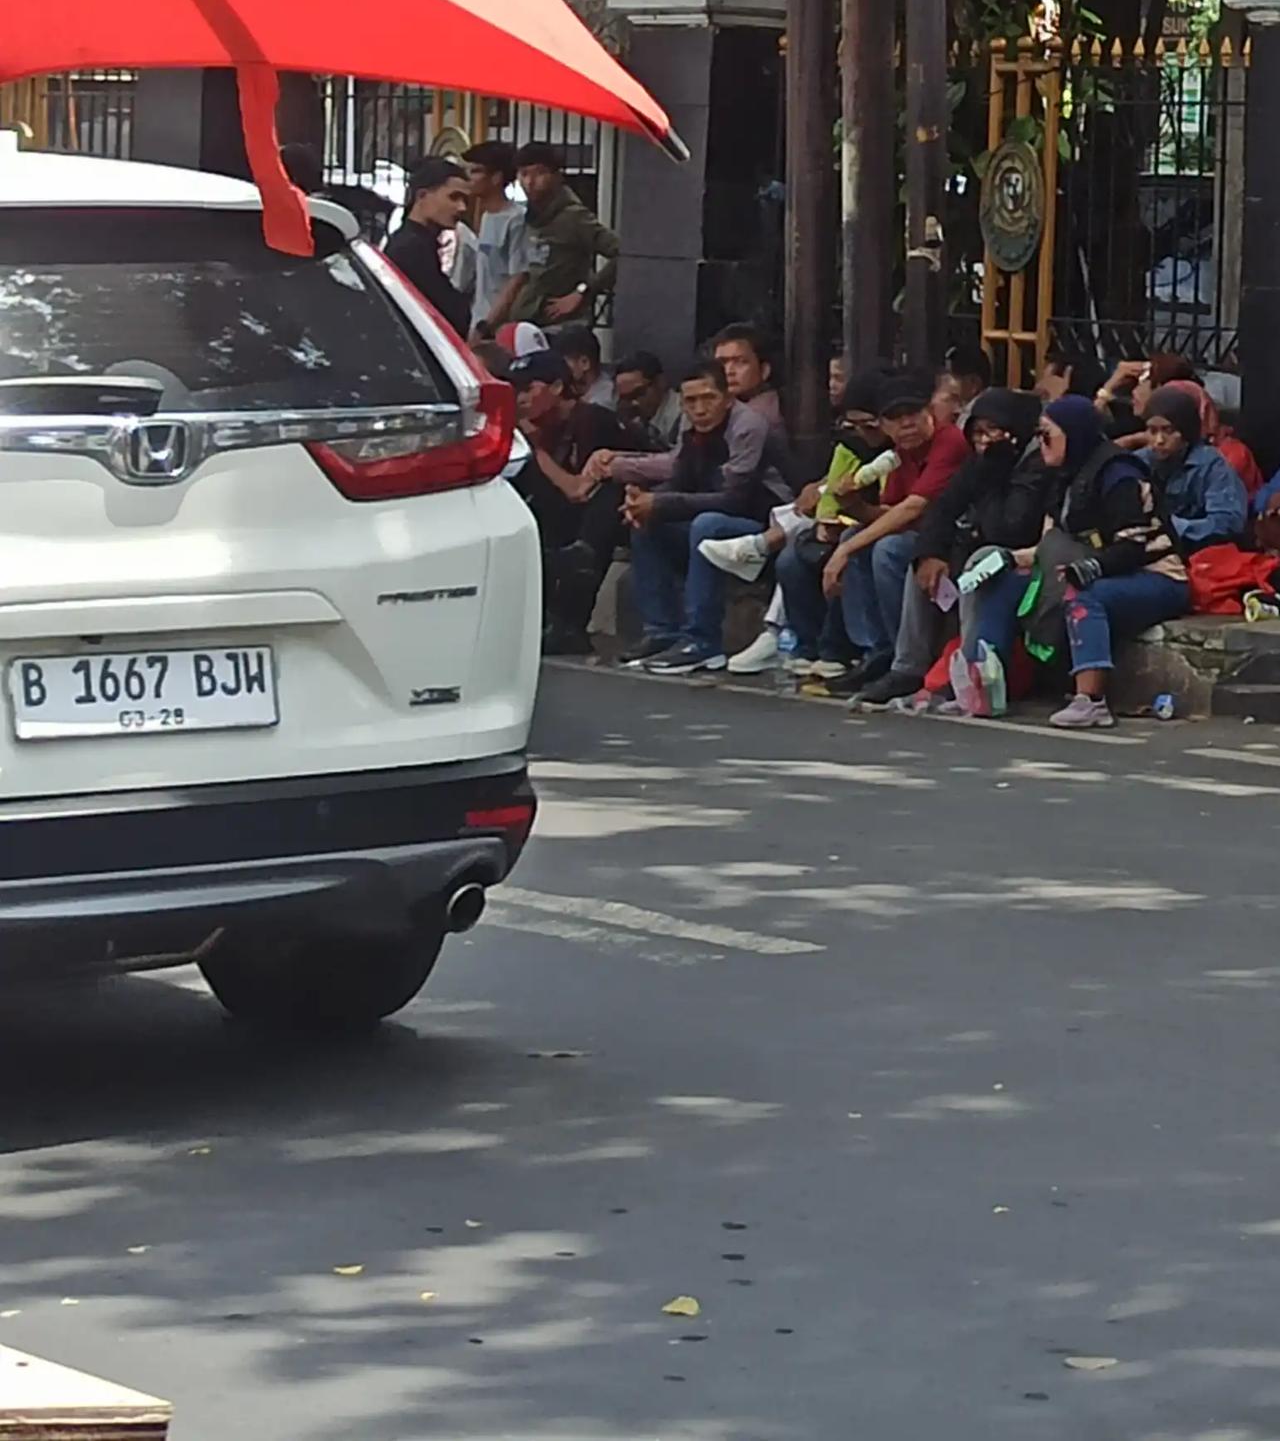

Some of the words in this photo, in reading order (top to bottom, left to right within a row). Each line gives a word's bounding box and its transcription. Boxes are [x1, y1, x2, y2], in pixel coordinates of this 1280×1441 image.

[21, 662, 47, 707] B
[72, 655, 169, 704] 1667
[193, 650, 266, 698] BJW
